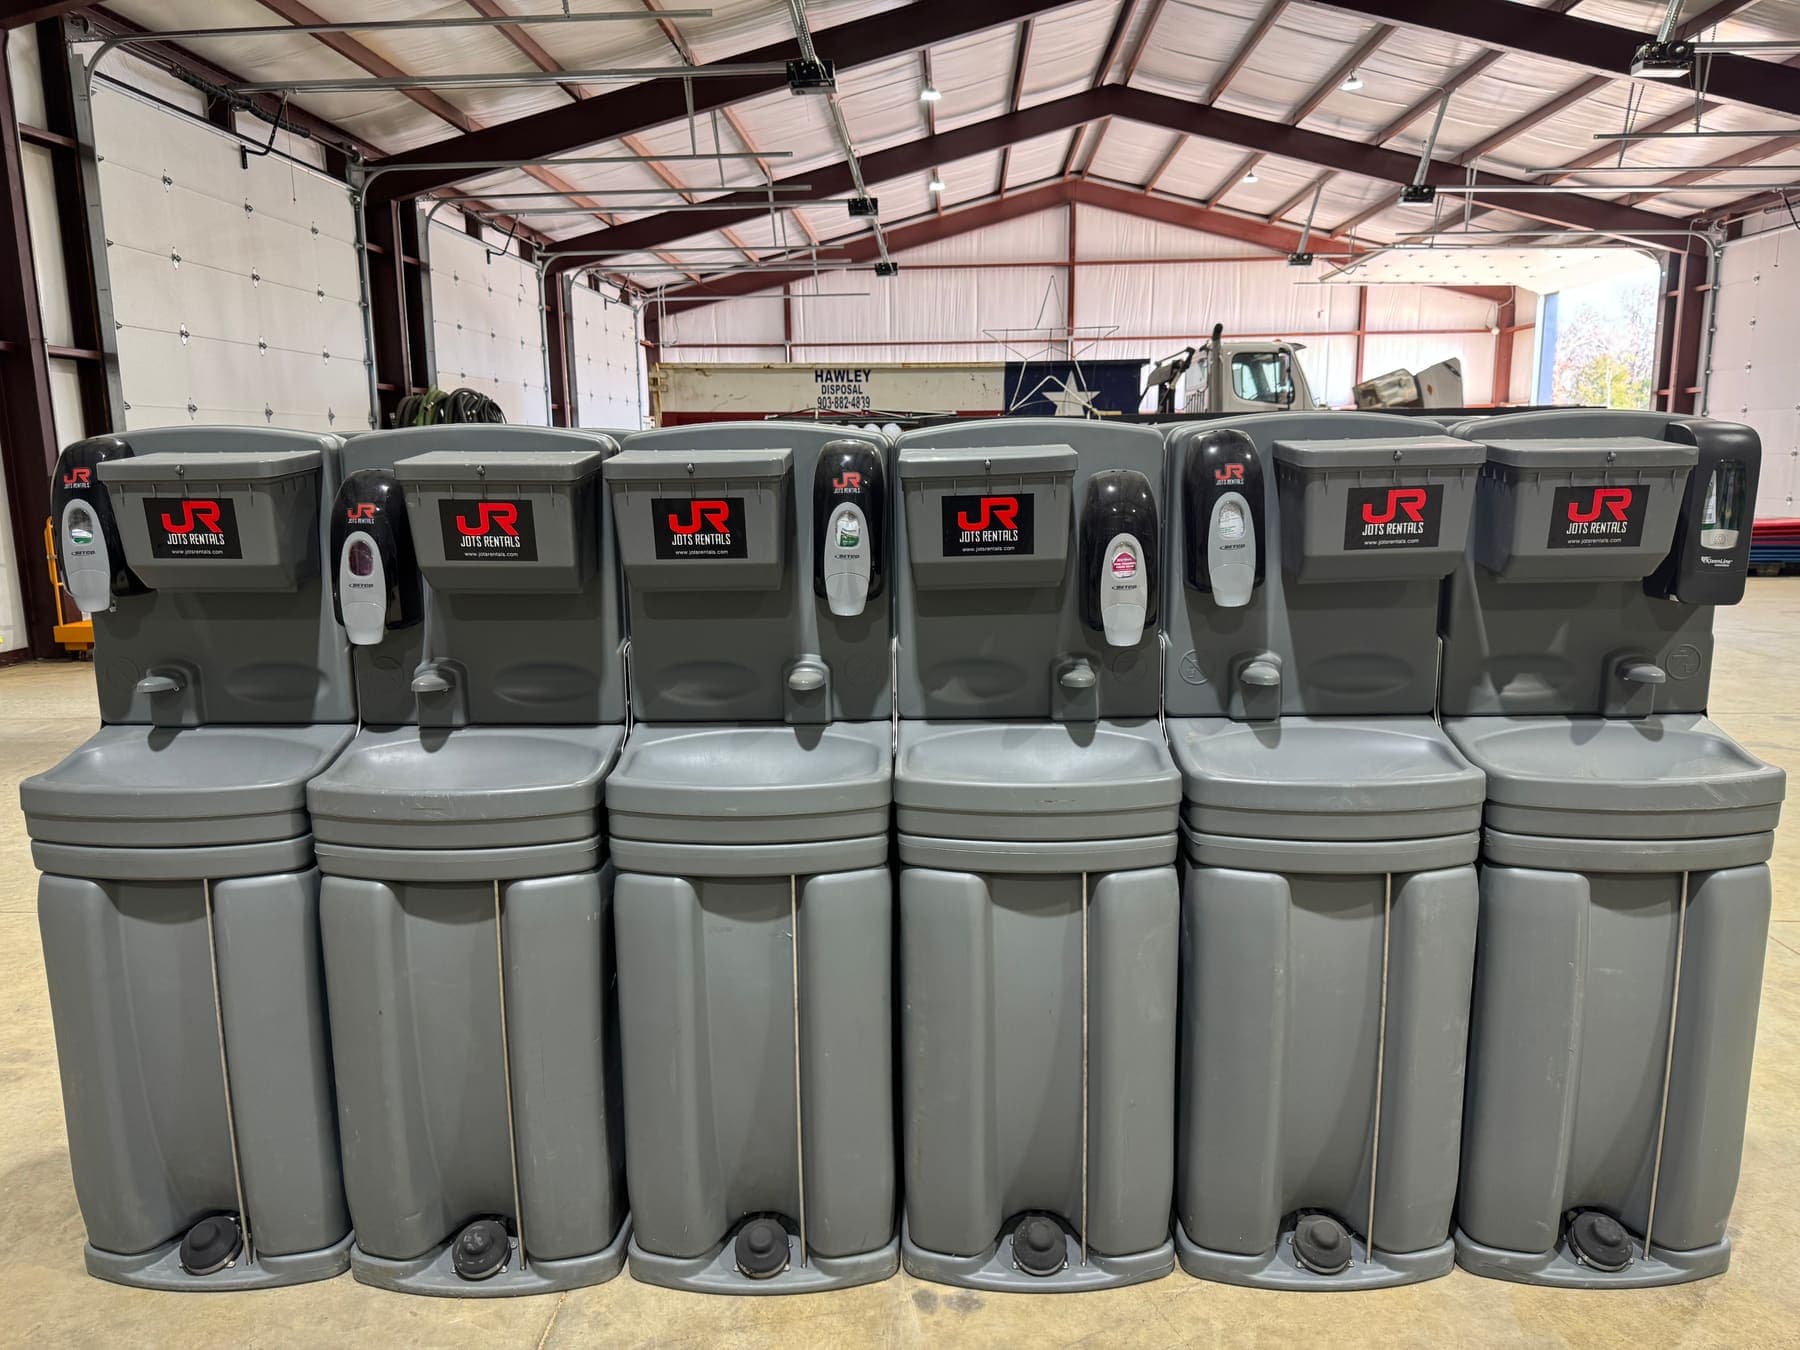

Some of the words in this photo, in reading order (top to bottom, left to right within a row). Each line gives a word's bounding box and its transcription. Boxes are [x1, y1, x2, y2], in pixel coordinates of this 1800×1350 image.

[815, 369, 871, 383] HAWLEY
[821, 384, 863, 395] DISPOSAL
[817, 396, 871, 409] 903-882-4839
[63, 468, 91, 484] JR
[1216, 464, 1244, 480] JR
[832, 472, 861, 488] JR
[346, 503, 376, 518] JR
[1363, 488, 1427, 524] JR
[1568, 488, 1632, 522] JR
[161, 500, 223, 534] JR
[456, 502, 519, 536] JR
[669, 500, 730, 534] JR
[958, 497, 1019, 531] JR
[1362, 523, 1385, 536] JOTS
[1386, 521, 1424, 535] RENTALS
[1566, 522, 1589, 535] JOTS
[1590, 521, 1628, 534] RENTALS
[167, 533, 188, 545] JOTS
[189, 533, 225, 545] RENTALS
[461, 535, 482, 548] JOTS
[483, 535, 520, 548] RENTALS
[672, 533, 693, 546] JOTS
[695, 533, 731, 545] RENTALS
[960, 530, 980, 543] JOTS
[982, 529, 1018, 542] RENTALS
